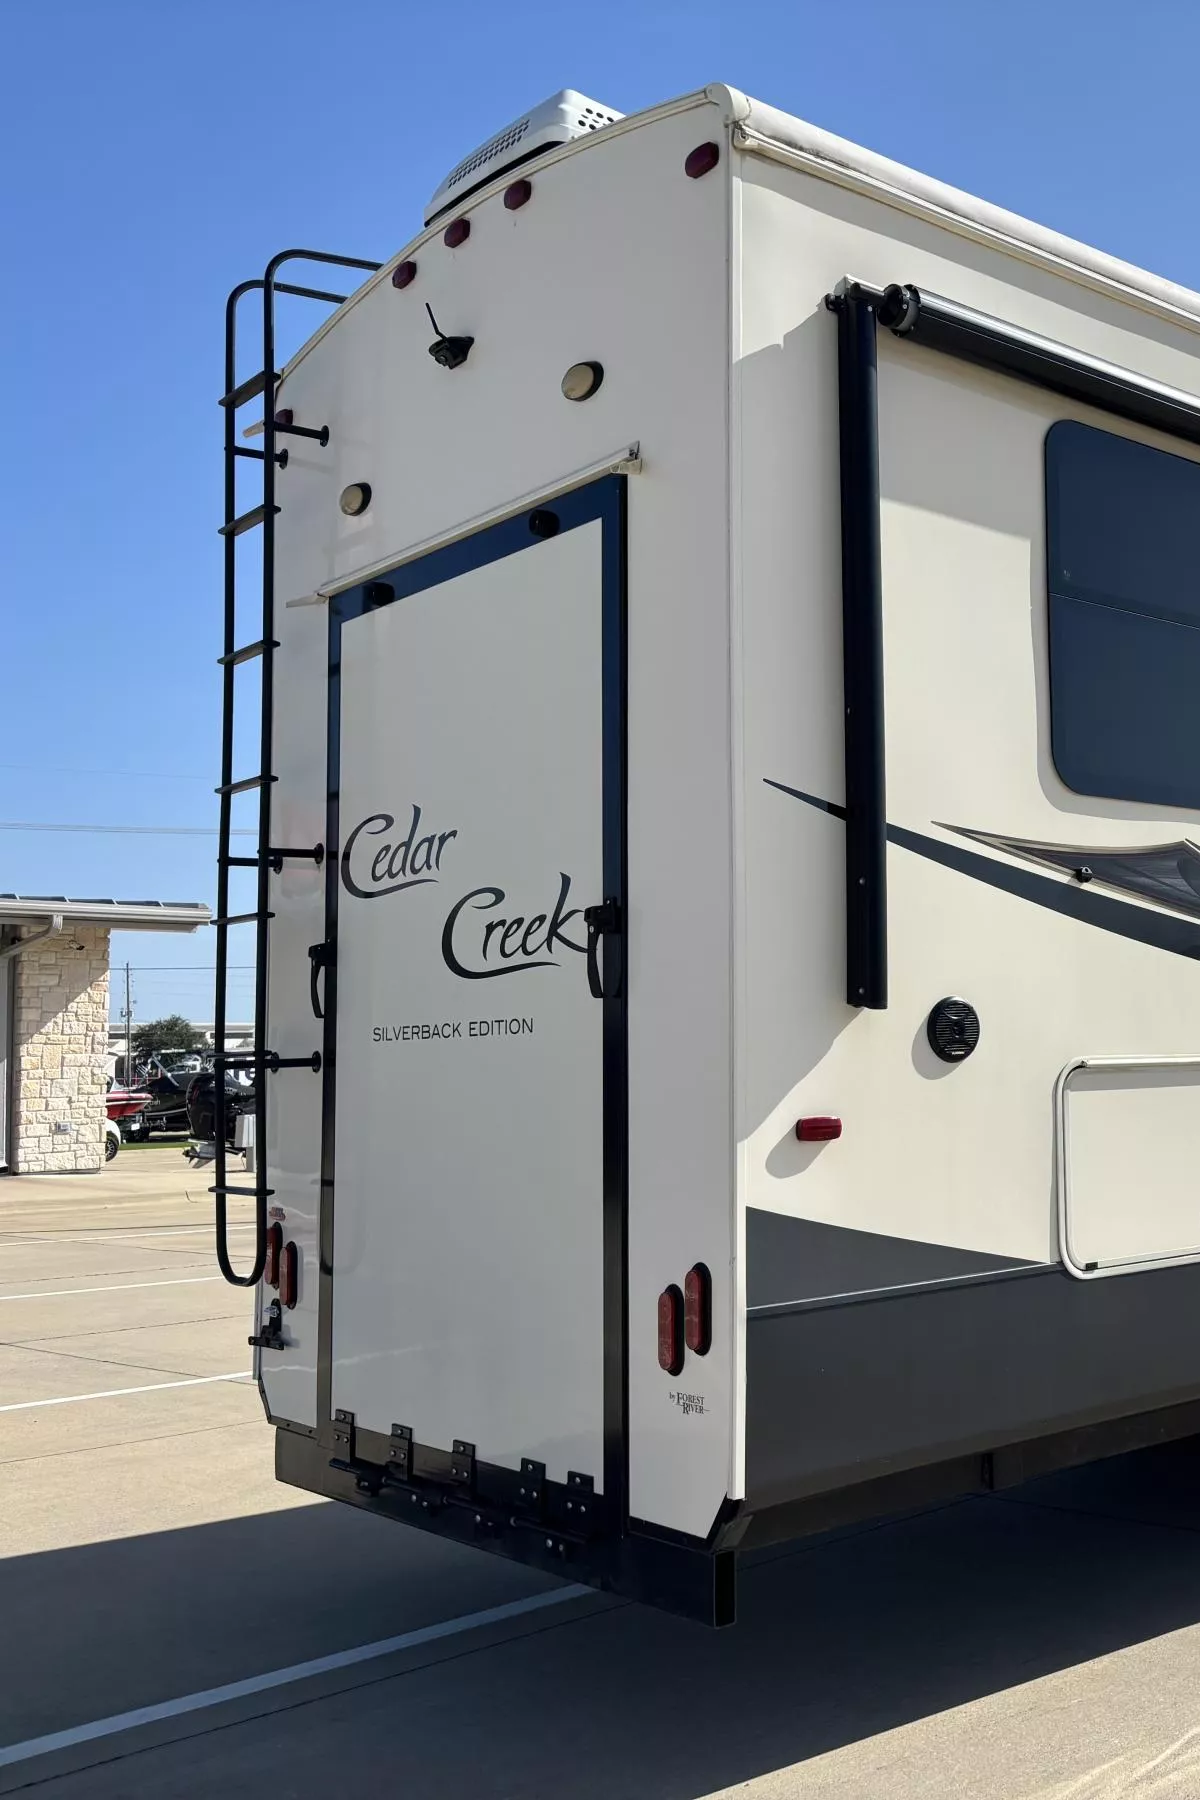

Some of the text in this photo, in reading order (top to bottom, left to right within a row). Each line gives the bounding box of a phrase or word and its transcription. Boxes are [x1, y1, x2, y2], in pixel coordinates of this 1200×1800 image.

[341, 803, 458, 899] Cedar
[441, 871, 588, 980] Creek
[372, 1017, 534, 1042] SILVERBACK EDITION
[677, 1391, 705, 1405] FOREST
[682, 1402, 704, 1415] RIVER
